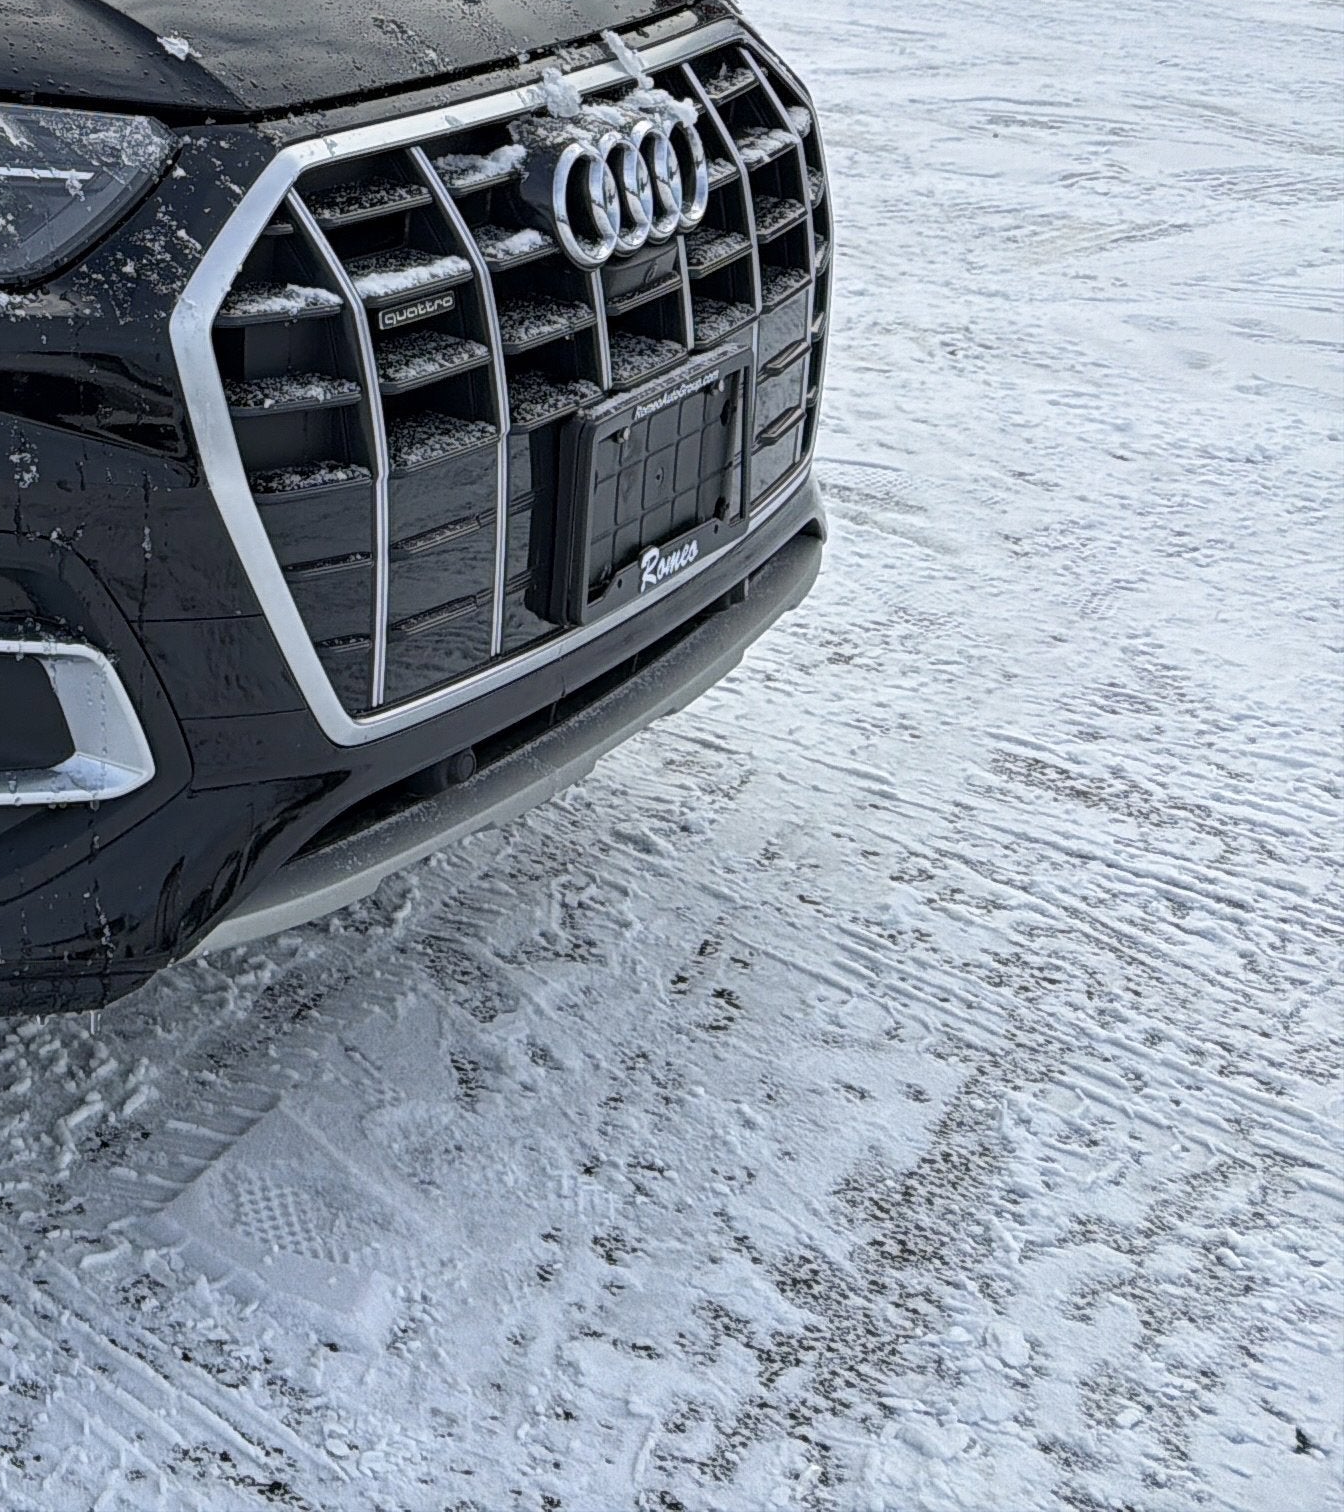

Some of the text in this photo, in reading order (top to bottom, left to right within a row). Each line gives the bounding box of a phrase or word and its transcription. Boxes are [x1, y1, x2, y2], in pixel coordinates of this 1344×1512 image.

[384, 295, 454, 325] quattro
[634, 370, 720, 421] RomeoAutoGroup.com
[640, 539, 699, 594] Romeo
